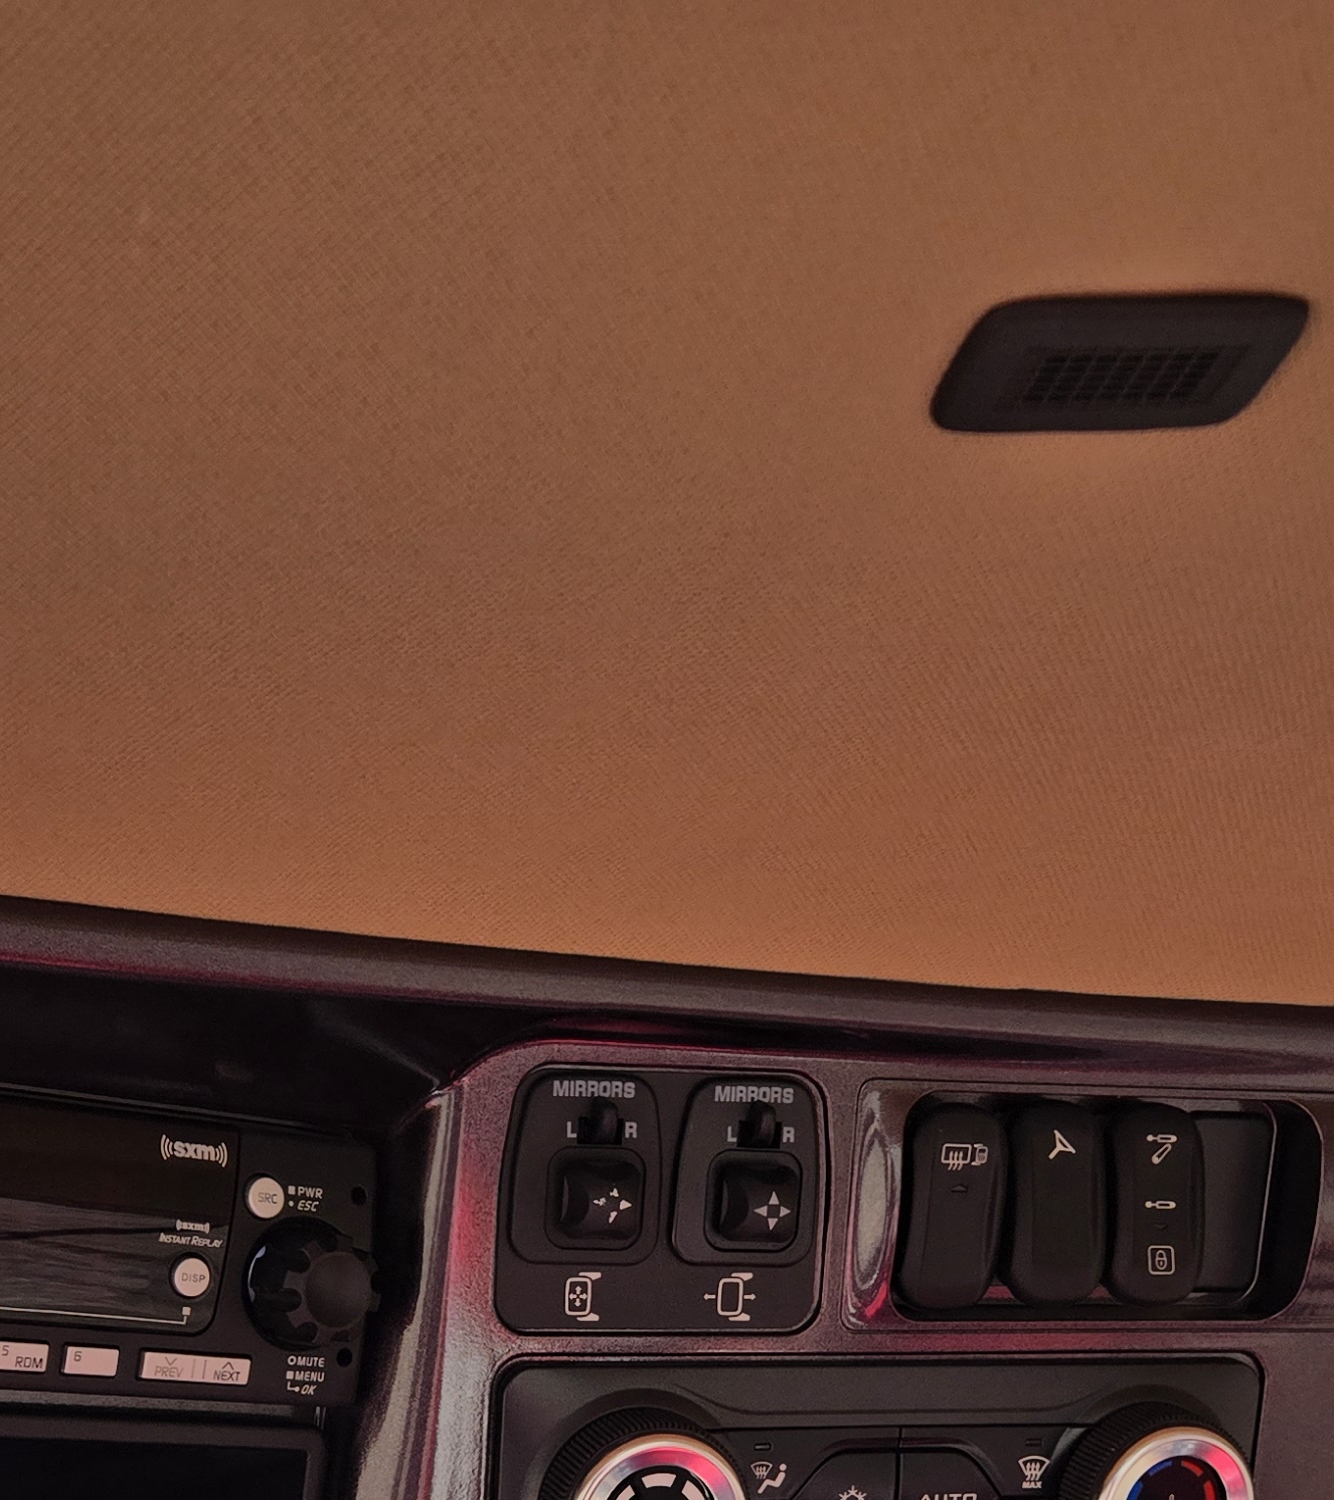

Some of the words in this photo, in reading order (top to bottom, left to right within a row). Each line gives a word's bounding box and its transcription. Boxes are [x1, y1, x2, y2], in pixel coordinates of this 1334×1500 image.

[552, 1080, 636, 1099] MIRRORS
[714, 1085, 794, 1104] MIRRORS
[567, 1122, 576, 1138] L
[624, 1122, 637, 1138] R
[728, 1127, 737, 1143] L
[782, 1127, 795, 1143] R
[258, 1191, 278, 1206] SRC
[298, 1186, 323, 1200] PWR
[297, 1200, 319, 1213] ESC
[181, 1272, 206, 1284] DISP
[1, 1344, 9, 1356] 5
[73, 1350, 82, 1362] 6
[14, 1355, 43, 1369] RDM
[298, 1355, 325, 1369] MUTE
[154, 1365, 183, 1378] PREV
[213, 1369, 241, 1383] NEXT
[294, 1370, 325, 1383] MENU
[300, 1384, 317, 1396] OK
